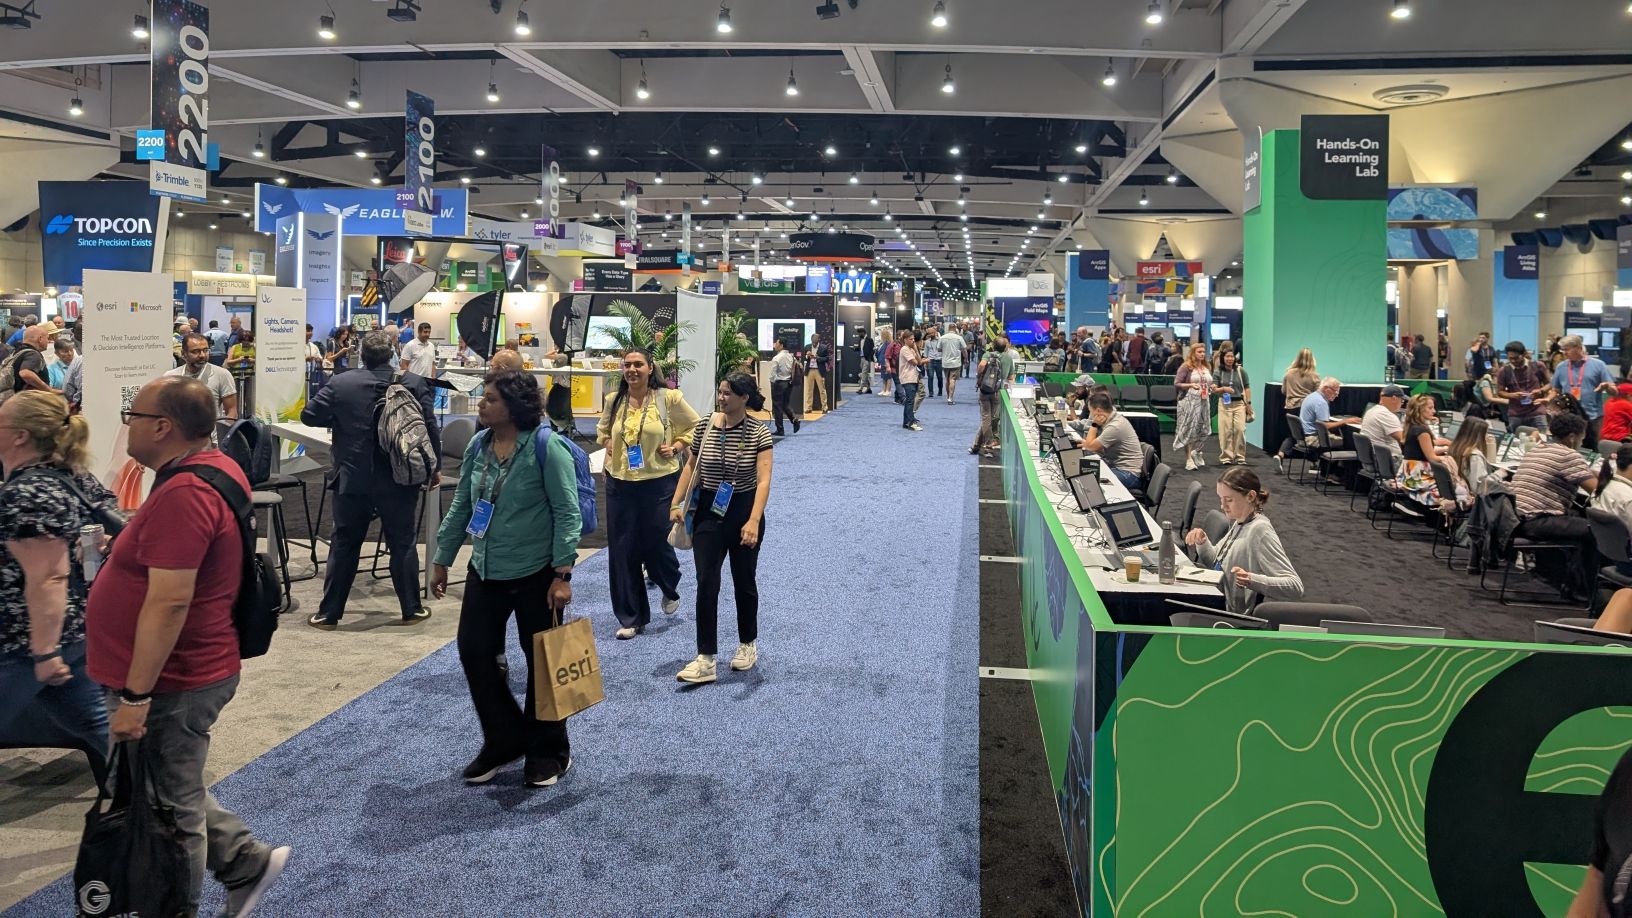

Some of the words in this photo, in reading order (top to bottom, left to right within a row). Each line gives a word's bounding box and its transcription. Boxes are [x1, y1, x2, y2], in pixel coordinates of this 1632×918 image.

[178, 25, 208, 163] 2200
[138, 137, 164, 147] 2200
[1316, 138, 1379, 149] Hands-On
[418, 117, 433, 210] 2100
[1324, 152, 1378, 165] Learning
[1355, 166, 1379, 177] Lab
[163, 172, 190, 187] Trimble
[396, 193, 415, 201] 2100
[359, 207, 453, 218] EAGLW
[74, 217, 153, 234] TOPCON
[490, 229, 511, 242] tyler
[1142, 264, 1162, 273] esri
[744, 279, 780, 288] VeiGIS
[104, 302, 117, 311] esri
[139, 303, 162, 311] Microsoft
[264, 318, 280, 326] Lights,
[556, 649, 593, 686] esri
